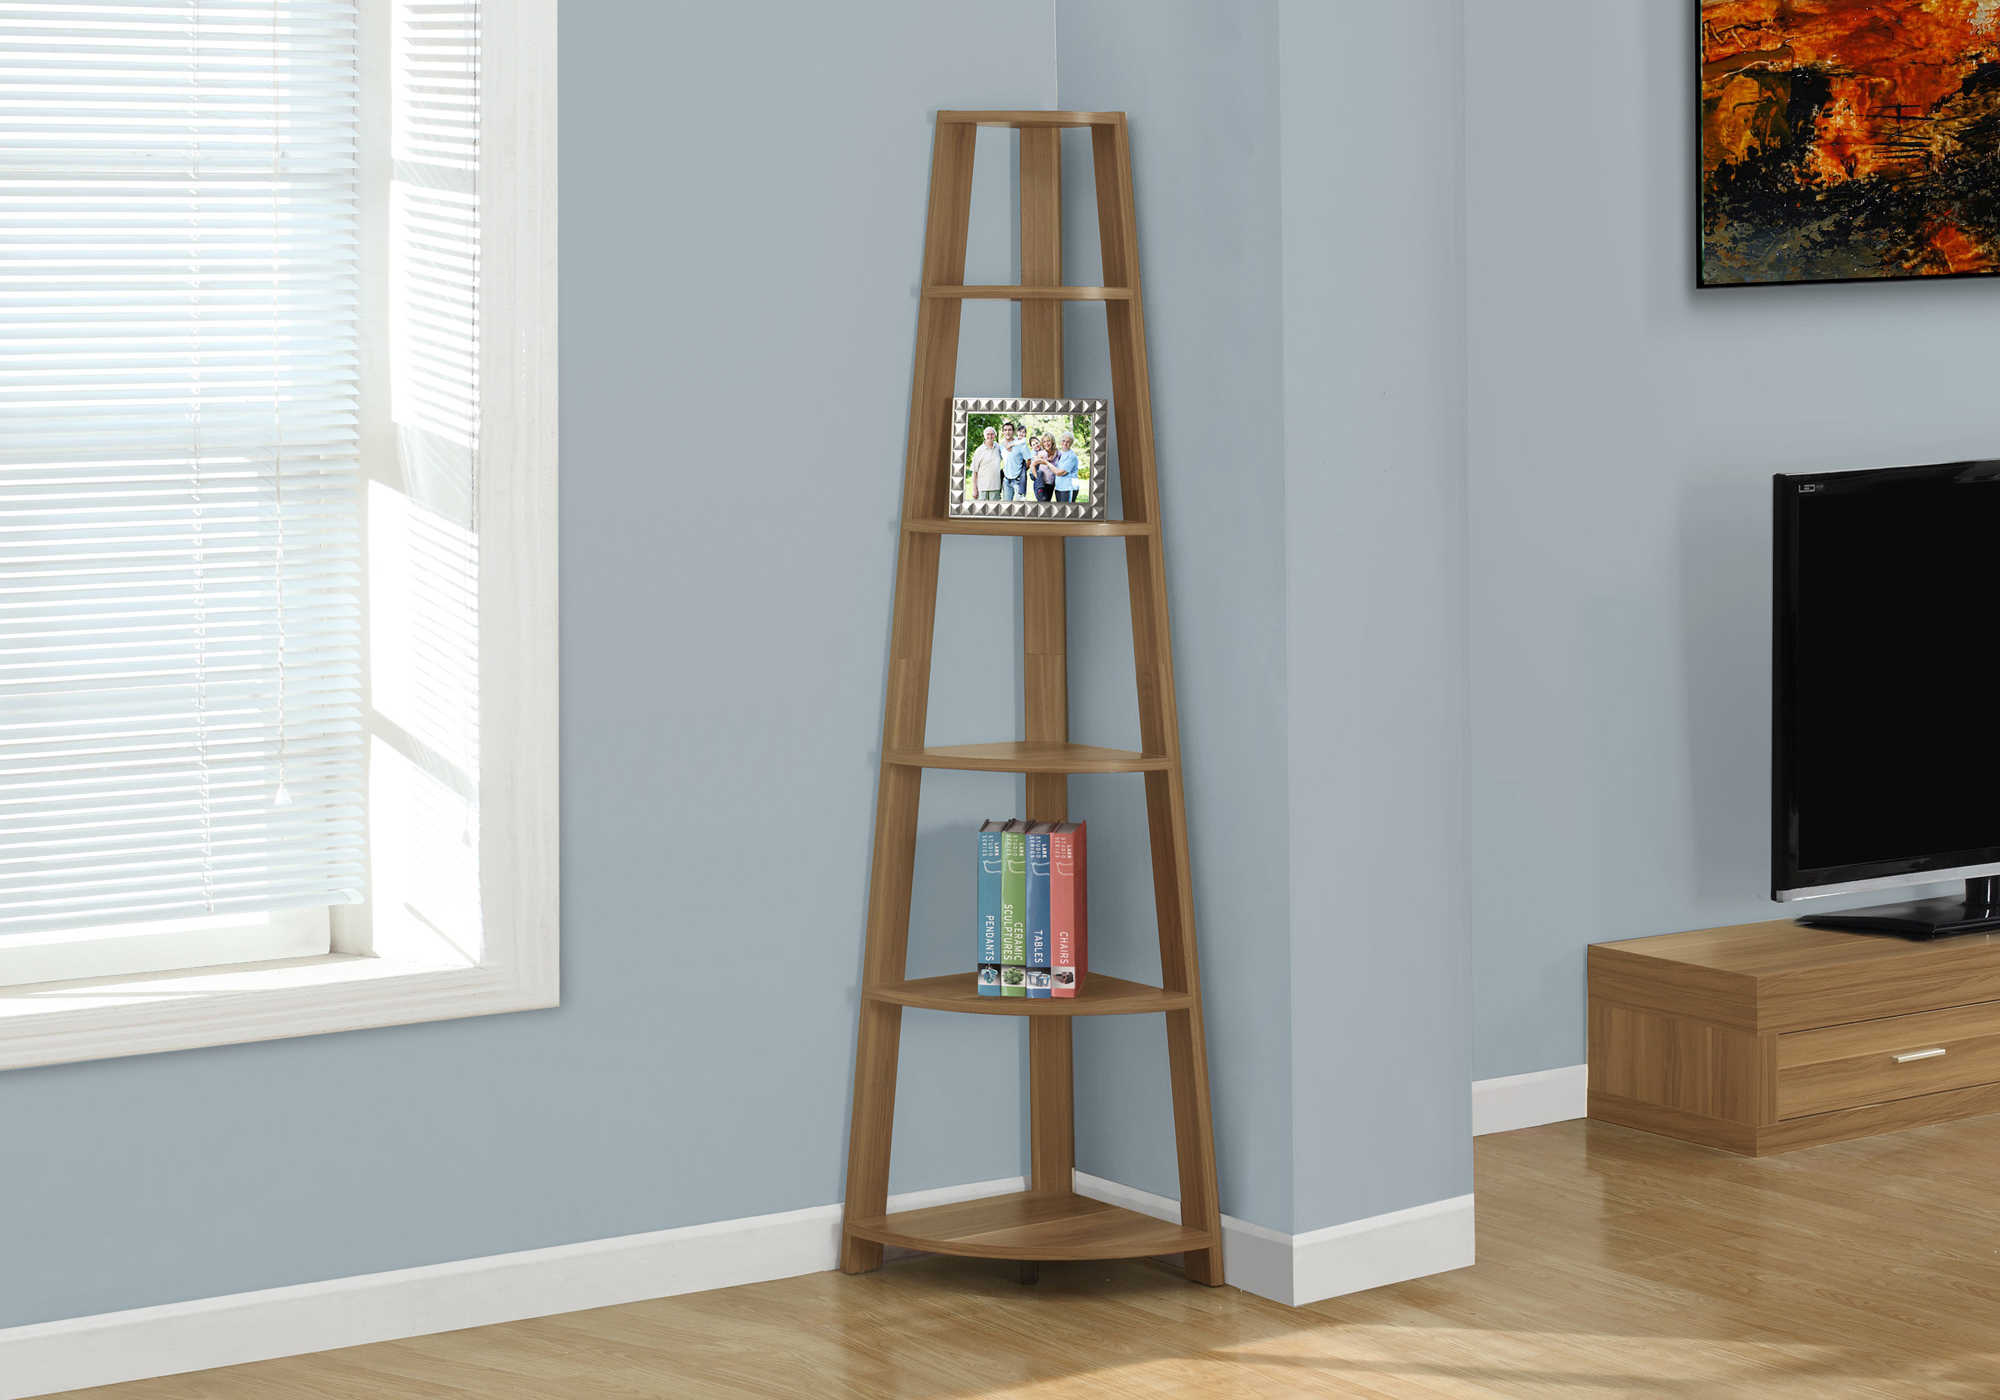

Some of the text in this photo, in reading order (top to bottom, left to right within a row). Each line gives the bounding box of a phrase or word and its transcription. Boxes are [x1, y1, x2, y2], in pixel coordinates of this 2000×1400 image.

[985, 915, 995, 962] PENDANTS
[1003, 904, 1013, 962] SCULPTURES
[1013, 922, 1023, 962] CERAMIC
[1034, 930, 1043, 964] TABLES
[1059, 931, 1069, 965] CHAIRS
